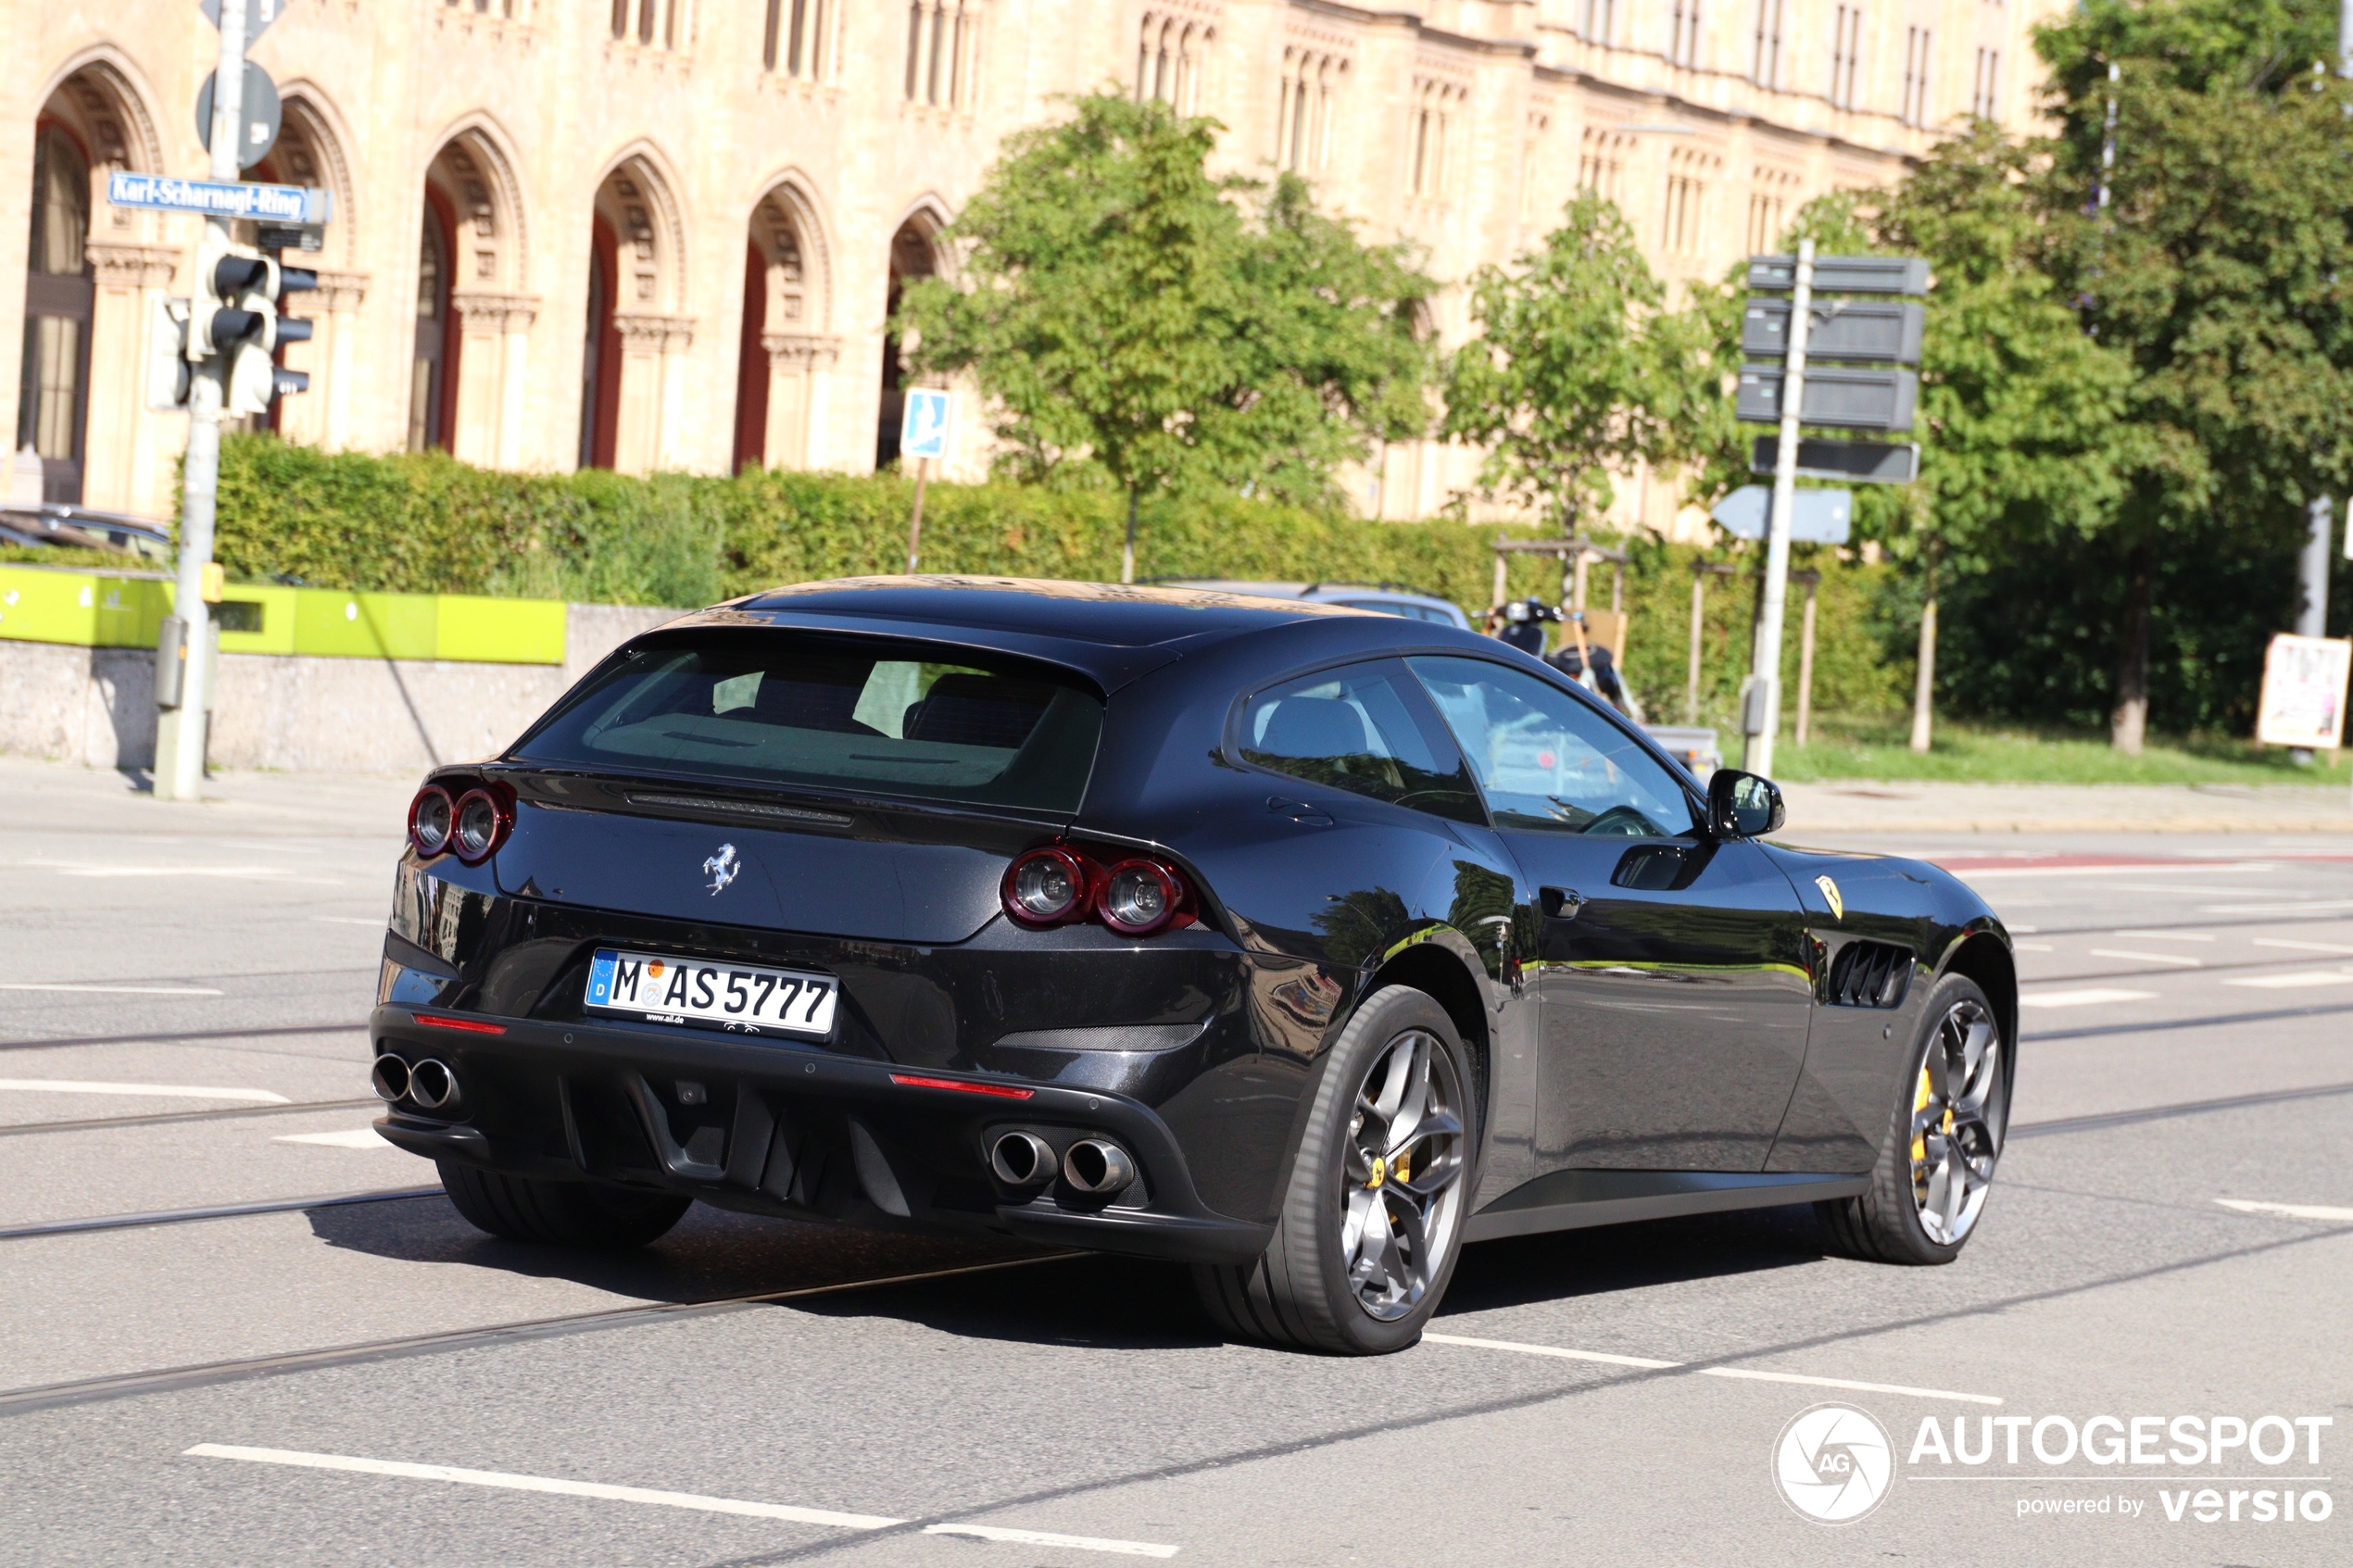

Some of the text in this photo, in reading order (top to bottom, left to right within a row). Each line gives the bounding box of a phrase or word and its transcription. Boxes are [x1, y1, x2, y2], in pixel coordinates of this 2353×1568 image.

[113, 177, 302, 220] Karl-Scharnagl-Ring
[596, 984, 605, 997] D
[612, 959, 642, 1001] M
